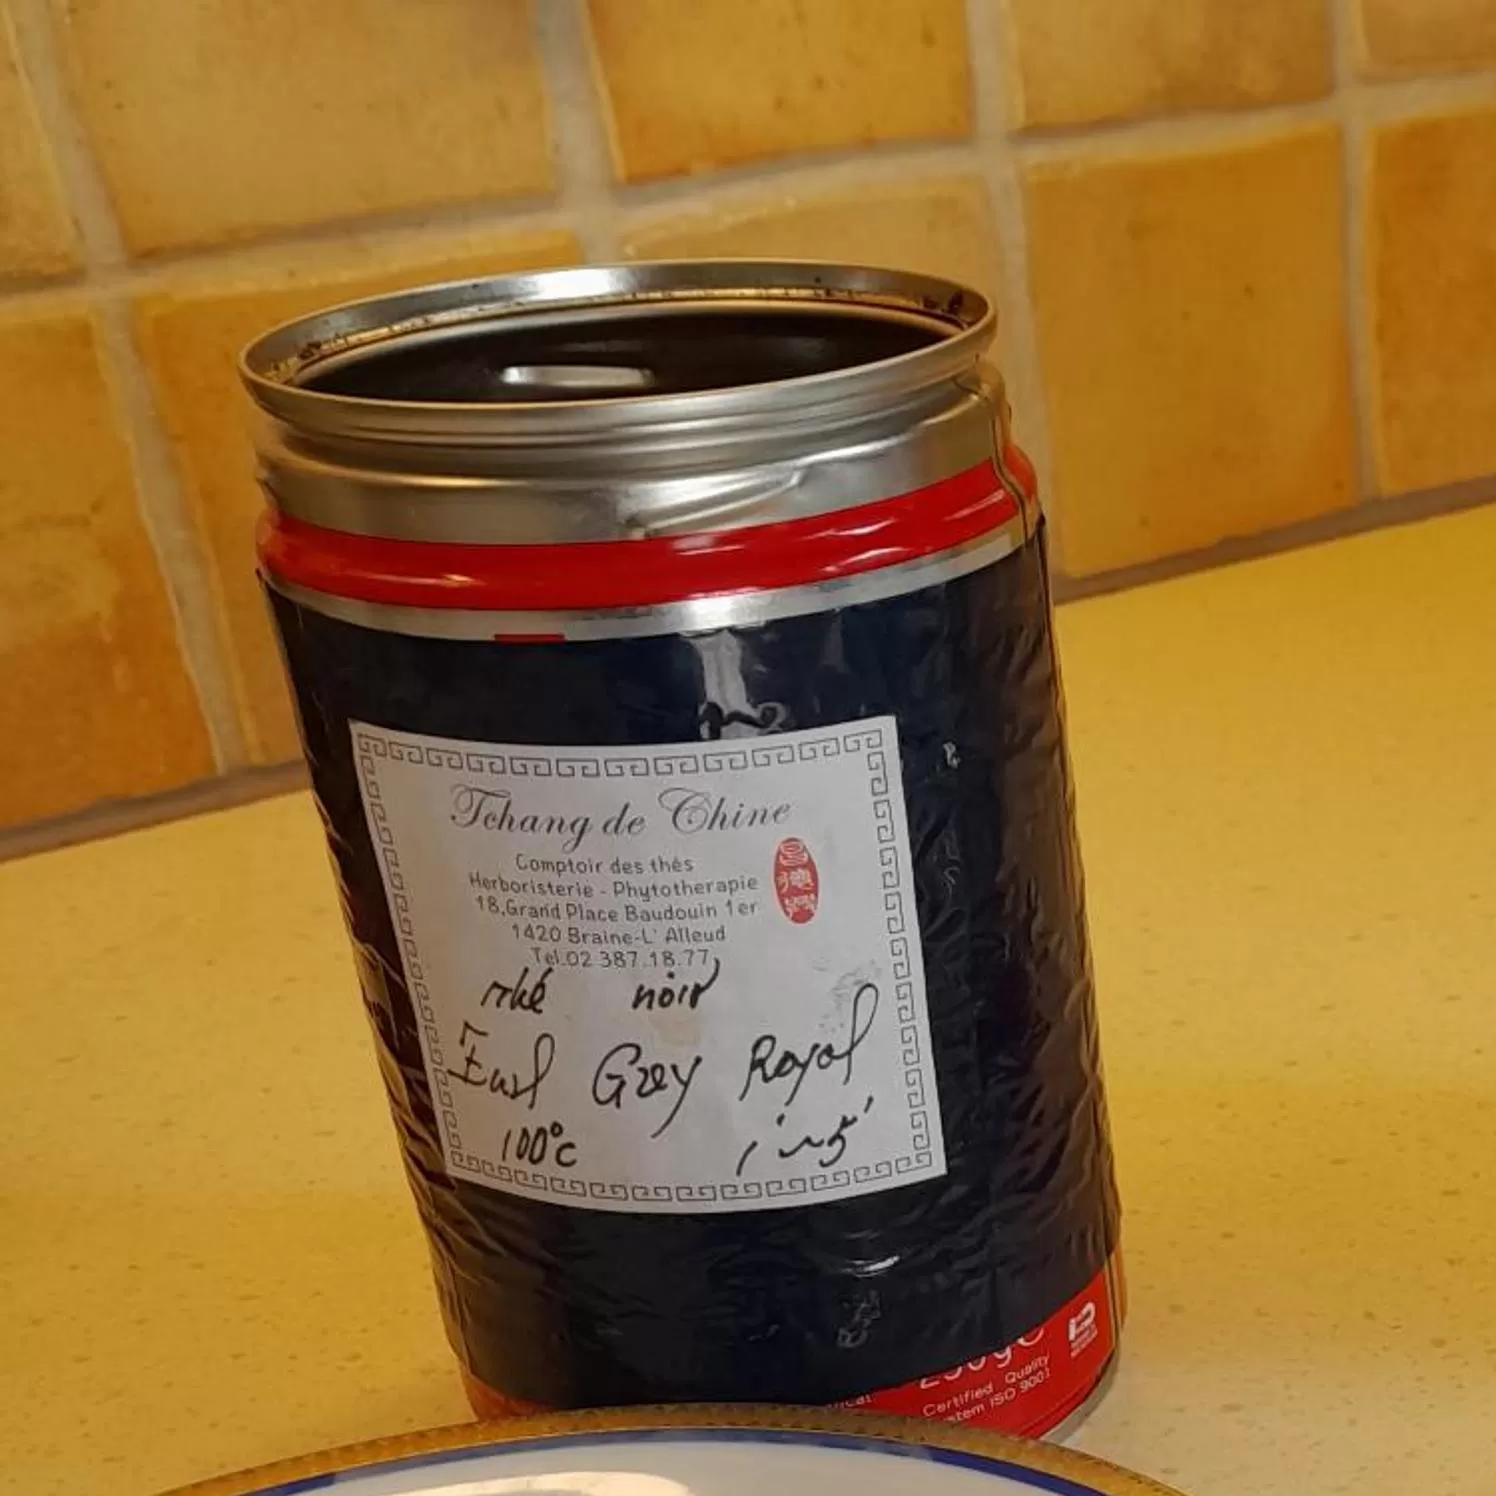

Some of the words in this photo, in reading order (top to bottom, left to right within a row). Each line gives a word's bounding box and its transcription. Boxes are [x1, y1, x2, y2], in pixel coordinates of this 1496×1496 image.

[451, 787, 593, 853] Tchang
[602, 802, 646, 836] de
[658, 788, 792, 834] Chine
[516, 853, 603, 875] Comptoir
[611, 857, 643, 874] des
[651, 856, 694, 873] thés
[469, 873, 594, 898] Herboristerie
[613, 877, 759, 900] Phytotherapie
[566, 904, 619, 922] Place
[625, 903, 717, 922] Baudouin
[725, 900, 758, 917] 1er
[511, 923, 561, 942] 1420
[632, 958, 720, 1010] noir
[446, 1020, 556, 1109] Earl
[591, 1042, 703, 1139] Grey
[738, 983, 880, 1106] Royal
[923, 1381, 994, 1417] Certified
[1005, 1354, 1050, 1384] Quality
[990, 1386, 1016, 1408] ISO
